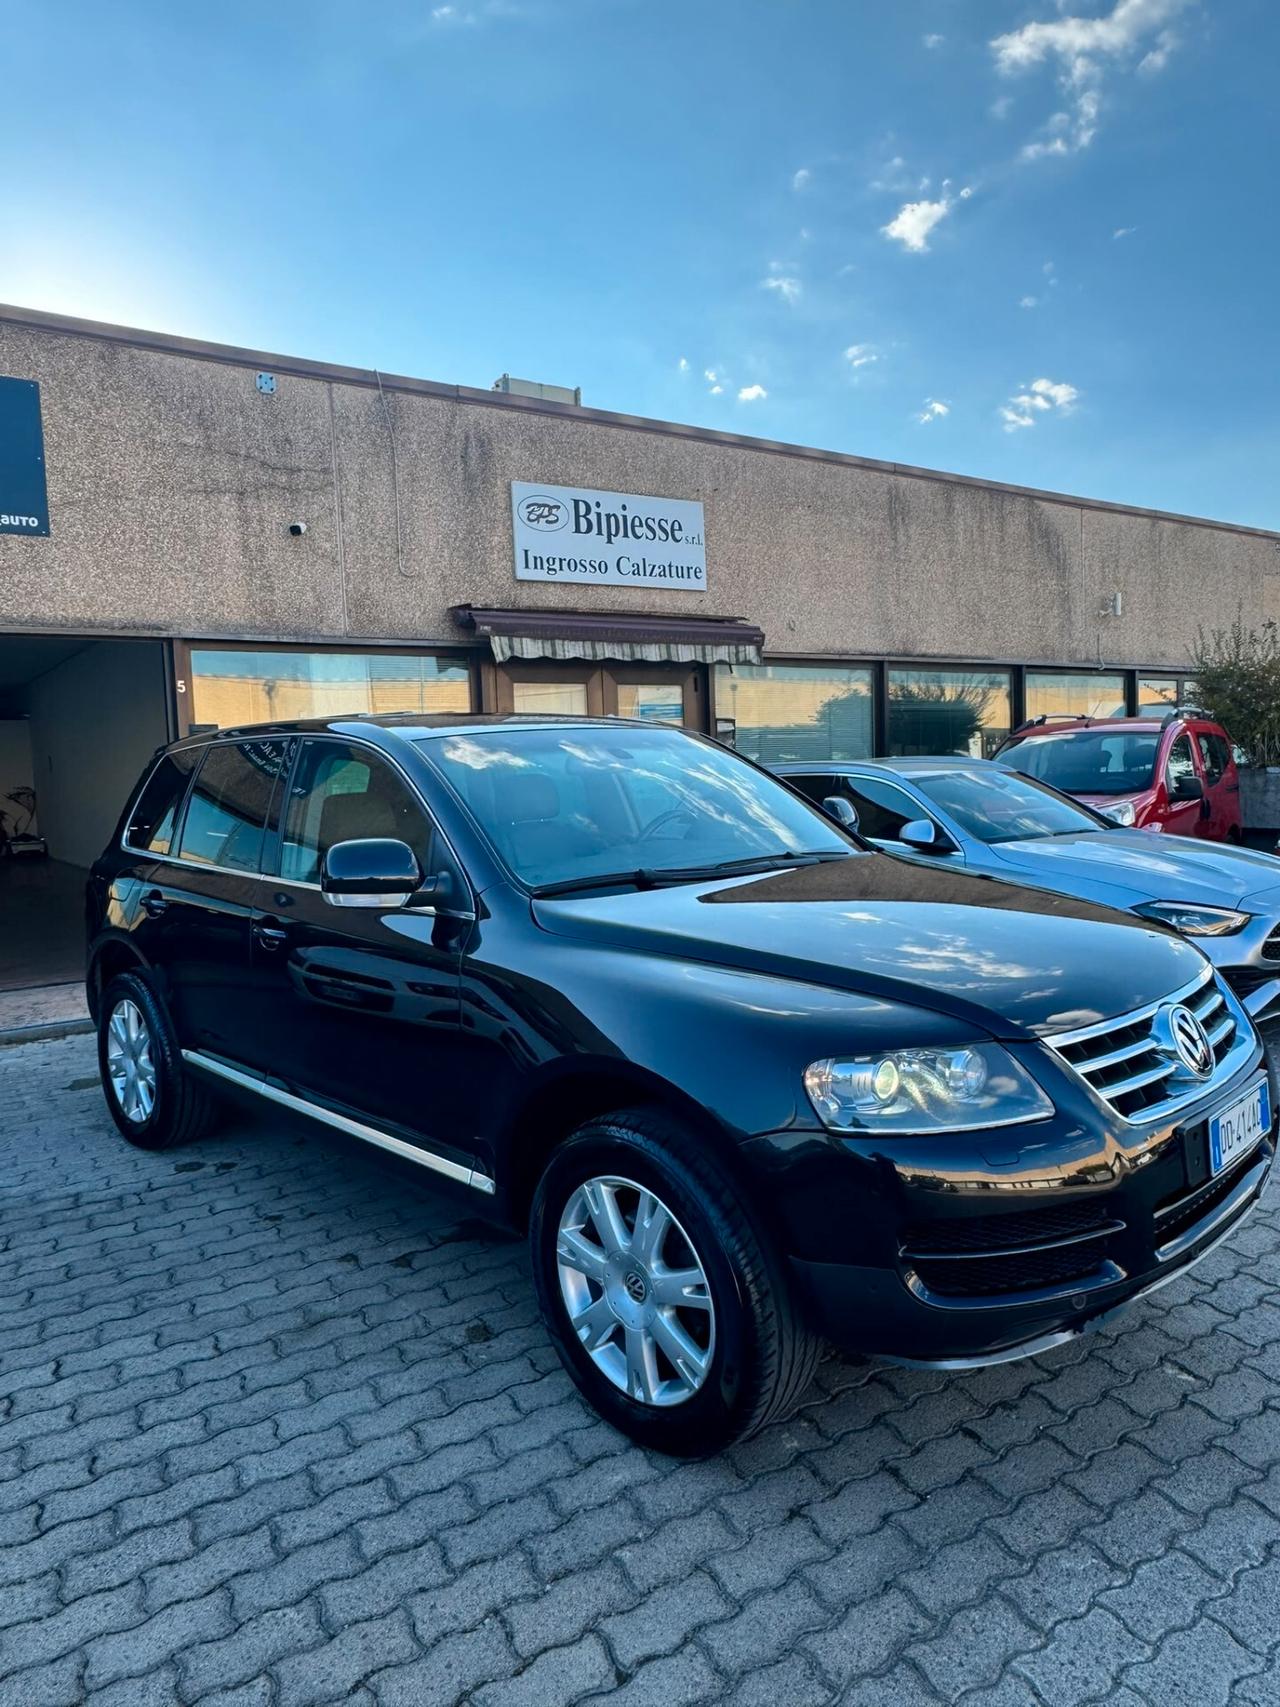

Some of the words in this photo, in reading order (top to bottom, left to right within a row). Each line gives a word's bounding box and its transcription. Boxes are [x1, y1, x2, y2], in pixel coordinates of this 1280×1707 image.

[571, 498, 683, 544] Bipiesse
[685, 533, 703, 546] s.r.l.
[523, 549, 609, 576] Ingrosso
[616, 556, 702, 580] Calzature
[176, 680, 186, 693] 5
